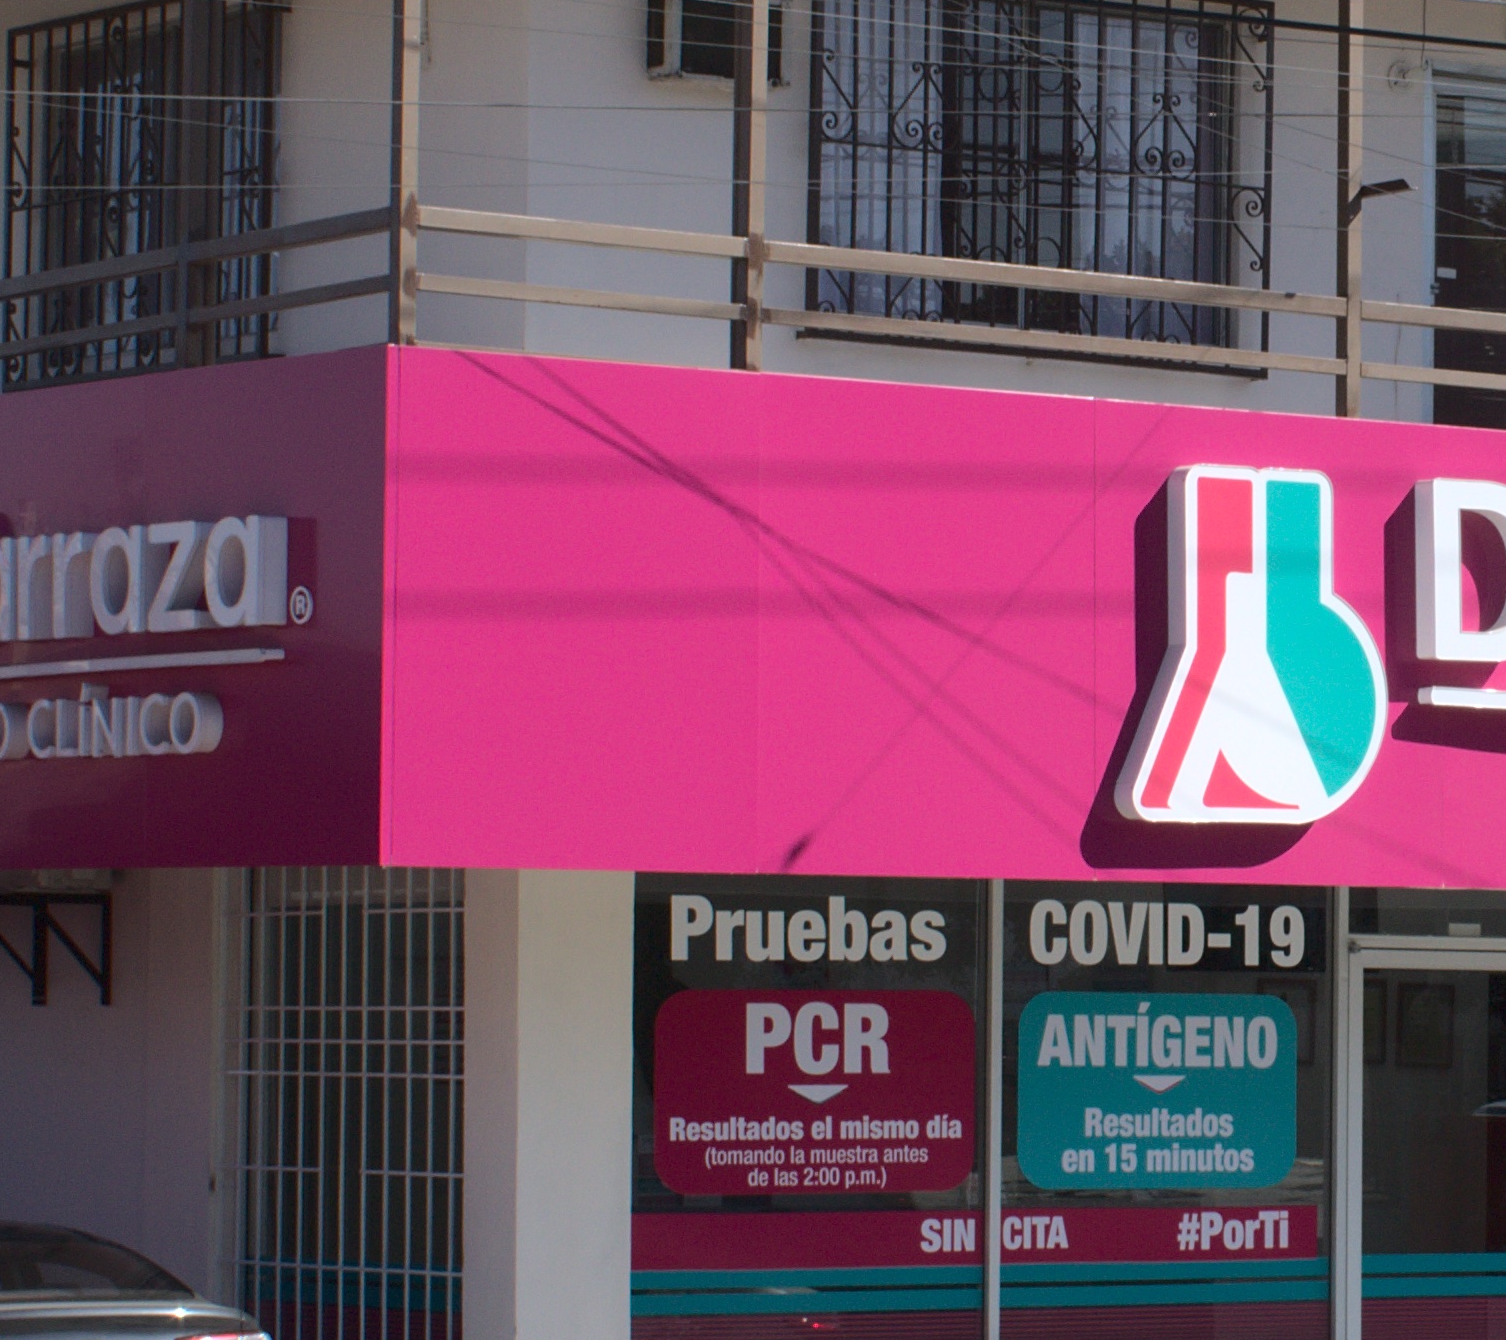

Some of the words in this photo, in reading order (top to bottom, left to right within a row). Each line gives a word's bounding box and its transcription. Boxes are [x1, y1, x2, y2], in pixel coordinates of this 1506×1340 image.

[27, 681, 224, 760] CLÍNICO
[669, 895, 948, 964] Pruebas
[1029, 899, 1306, 968] COVID-19
[744, 1001, 891, 1075] PCR
[1037, 1002, 1278, 1070] ANTÍGENO
[669, 1116, 804, 1142] Resultados
[811, 1116, 833, 1140] el
[840, 1115, 920, 1140] mismo
[926, 1114, 963, 1139] día
[1084, 1107, 1235, 1138] Resultados
[705, 1146, 786, 1169] (tomando
[790, 1146, 806, 1165] la
[810, 1147, 878, 1165] muestra
[883, 1145, 929, 1164] antes
[1061, 1147, 1095, 1174] en
[1104, 1143, 1138, 1174] 15
[1145, 1142, 1256, 1173] minutos
[748, 1168, 769, 1187] de
[773, 1167, 798, 1187] las
[803, 1167, 841, 1187] 2:00
[845, 1166, 887, 1189] p.m.)
[920, 1218, 977, 1253] SIN
[1002, 1215, 1069, 1250] CITA
[1177, 1210, 1290, 1250] #PorTi
